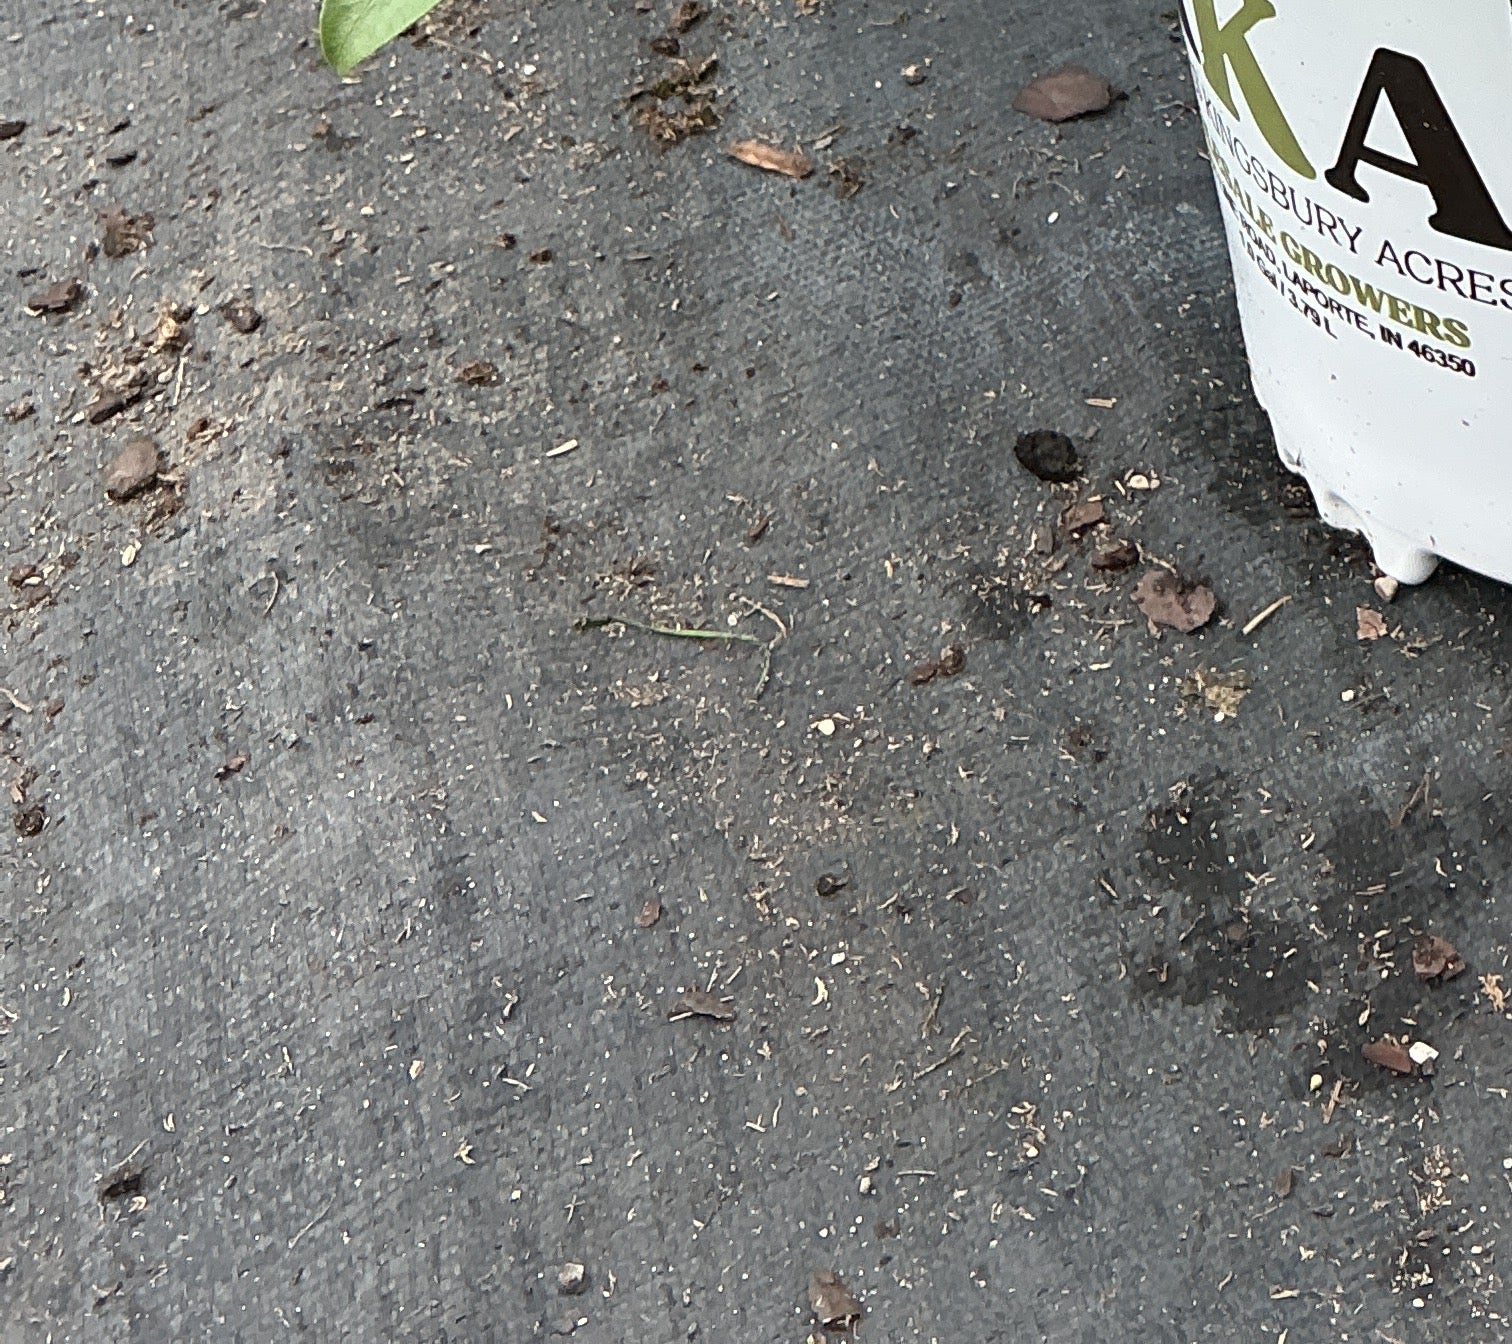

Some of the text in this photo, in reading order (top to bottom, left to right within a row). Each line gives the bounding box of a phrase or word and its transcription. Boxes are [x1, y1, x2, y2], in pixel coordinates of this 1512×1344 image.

[1279, 231, 1472, 349] GROWERS
[1282, 260, 1376, 340] LAPORTE,
[1379, 322, 1404, 350] IN
[1407, 339, 1477, 377] 46350
